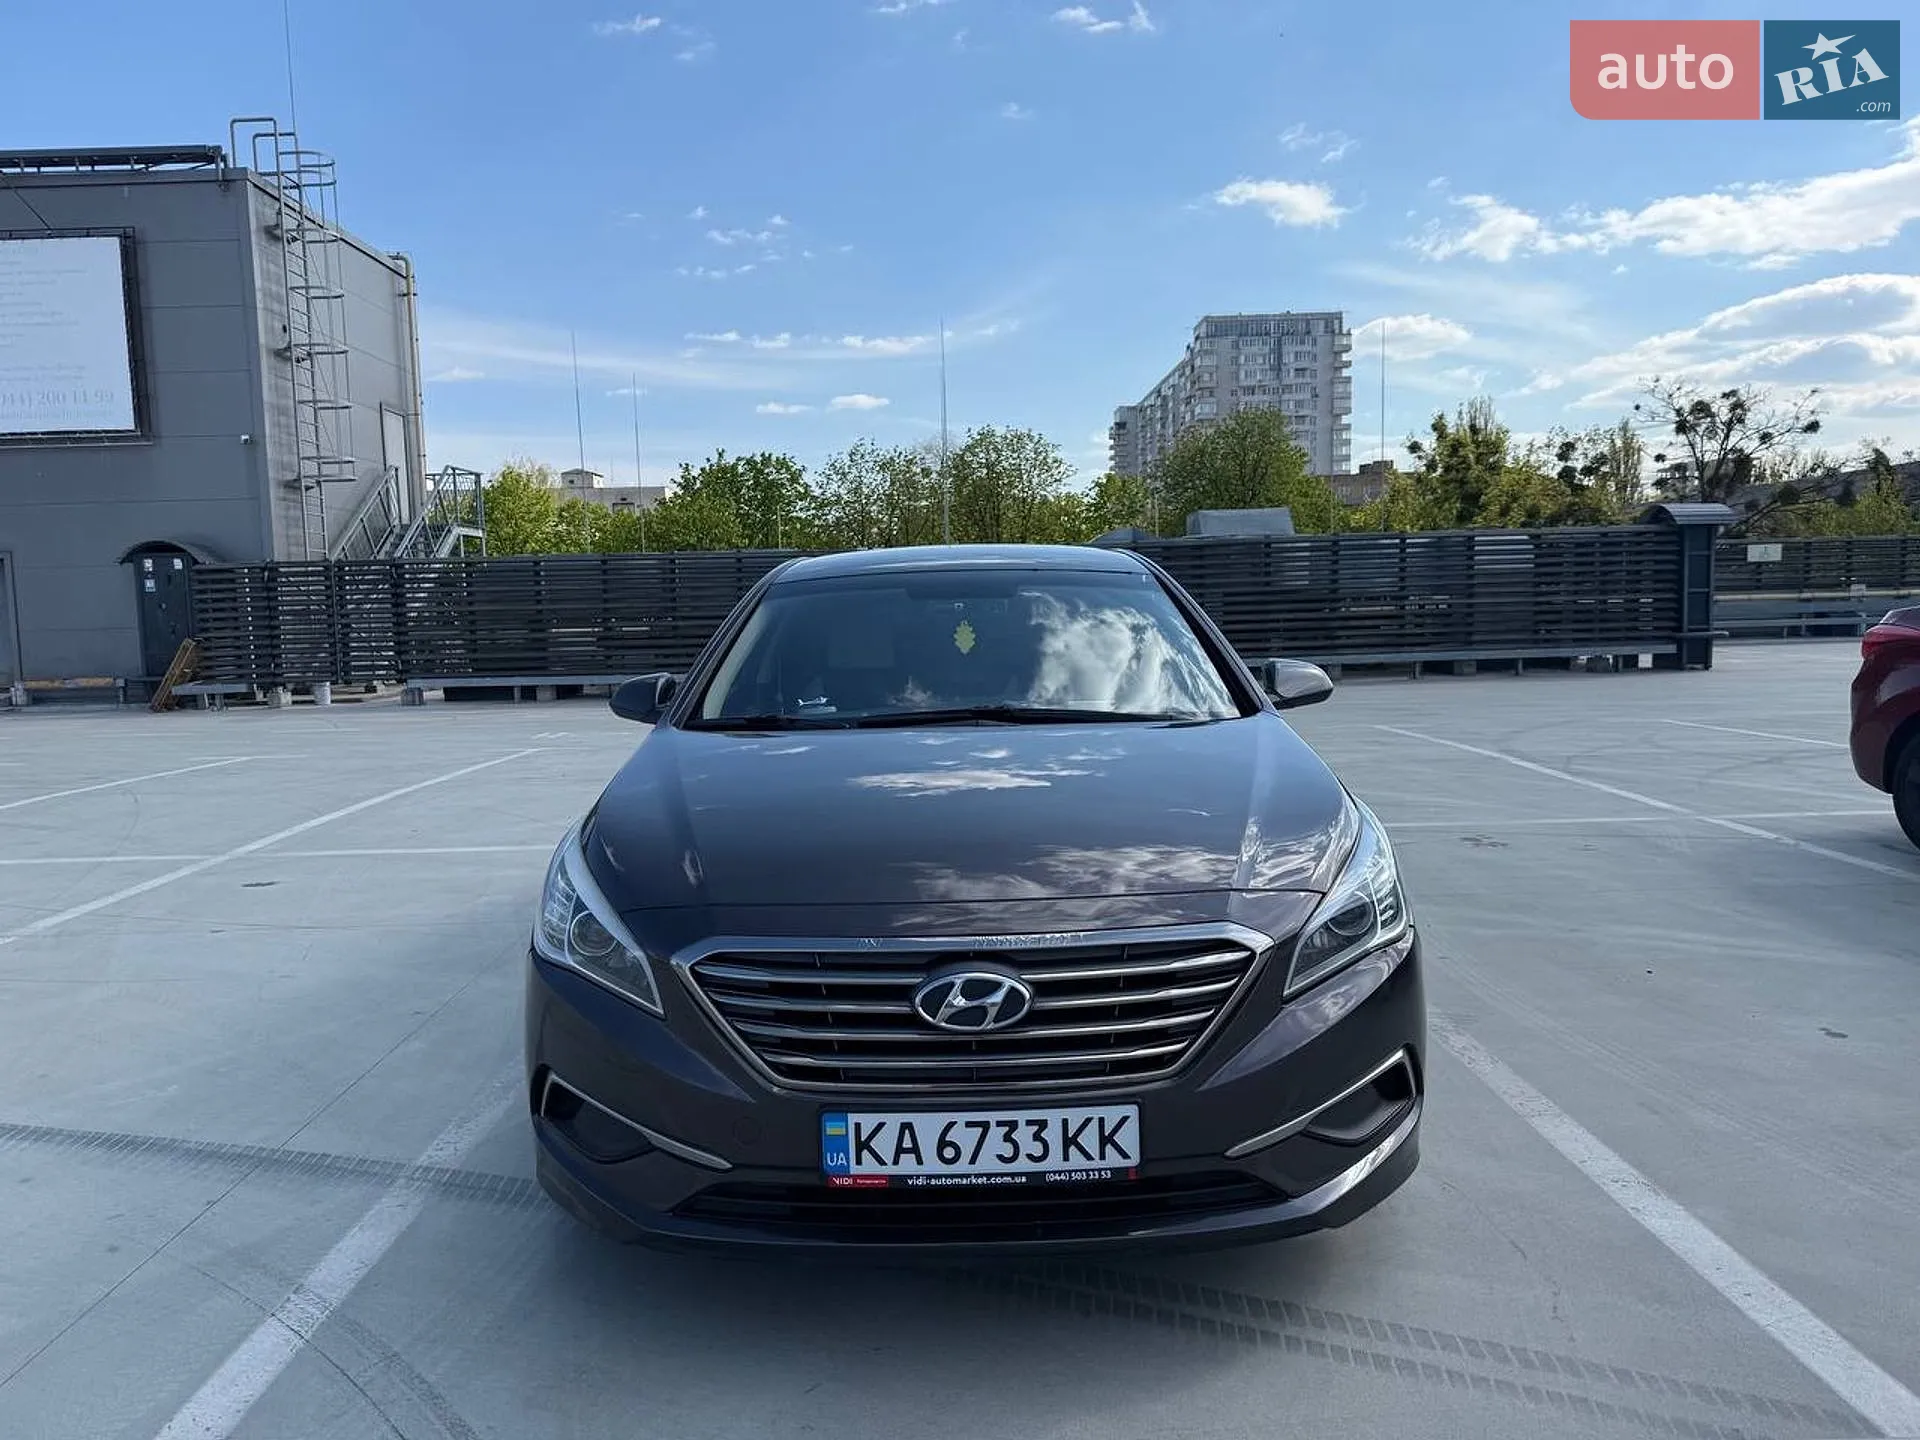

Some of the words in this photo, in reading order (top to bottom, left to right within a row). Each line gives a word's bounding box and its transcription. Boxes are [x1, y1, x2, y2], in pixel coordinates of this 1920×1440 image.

[853, 1120, 924, 1166] KA
[936, 1119, 1050, 1166] 6733
[1061, 1114, 1131, 1163] KK
[826, 1152, 848, 1167] UA
[1045, 1172, 1069, 1182] (044)
[1071, 1171, 1086, 1180] 503
